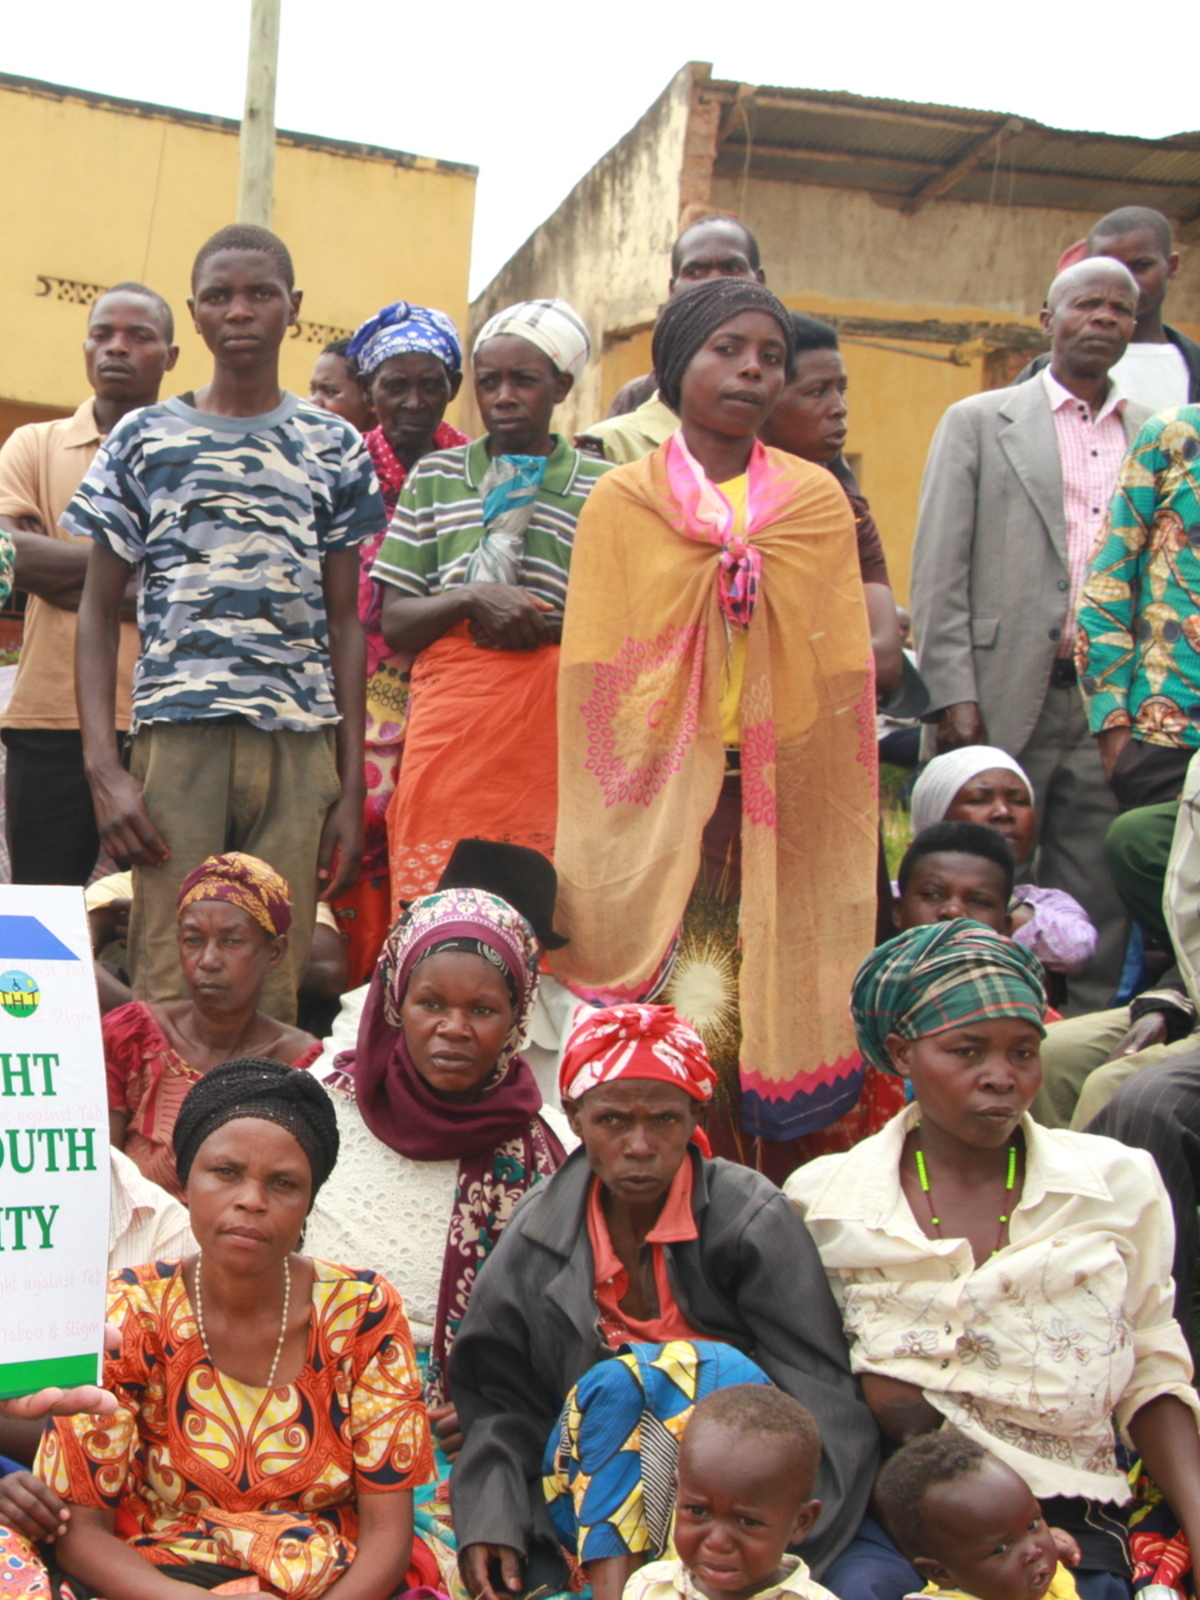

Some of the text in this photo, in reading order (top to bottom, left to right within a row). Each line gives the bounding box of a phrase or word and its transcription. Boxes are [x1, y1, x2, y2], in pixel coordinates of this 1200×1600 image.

[18, 1104, 74, 1127] against
[24, 1270, 76, 1297] against
[1, 1322, 44, 1343] Taboo
[48, 1319, 60, 1340] &
